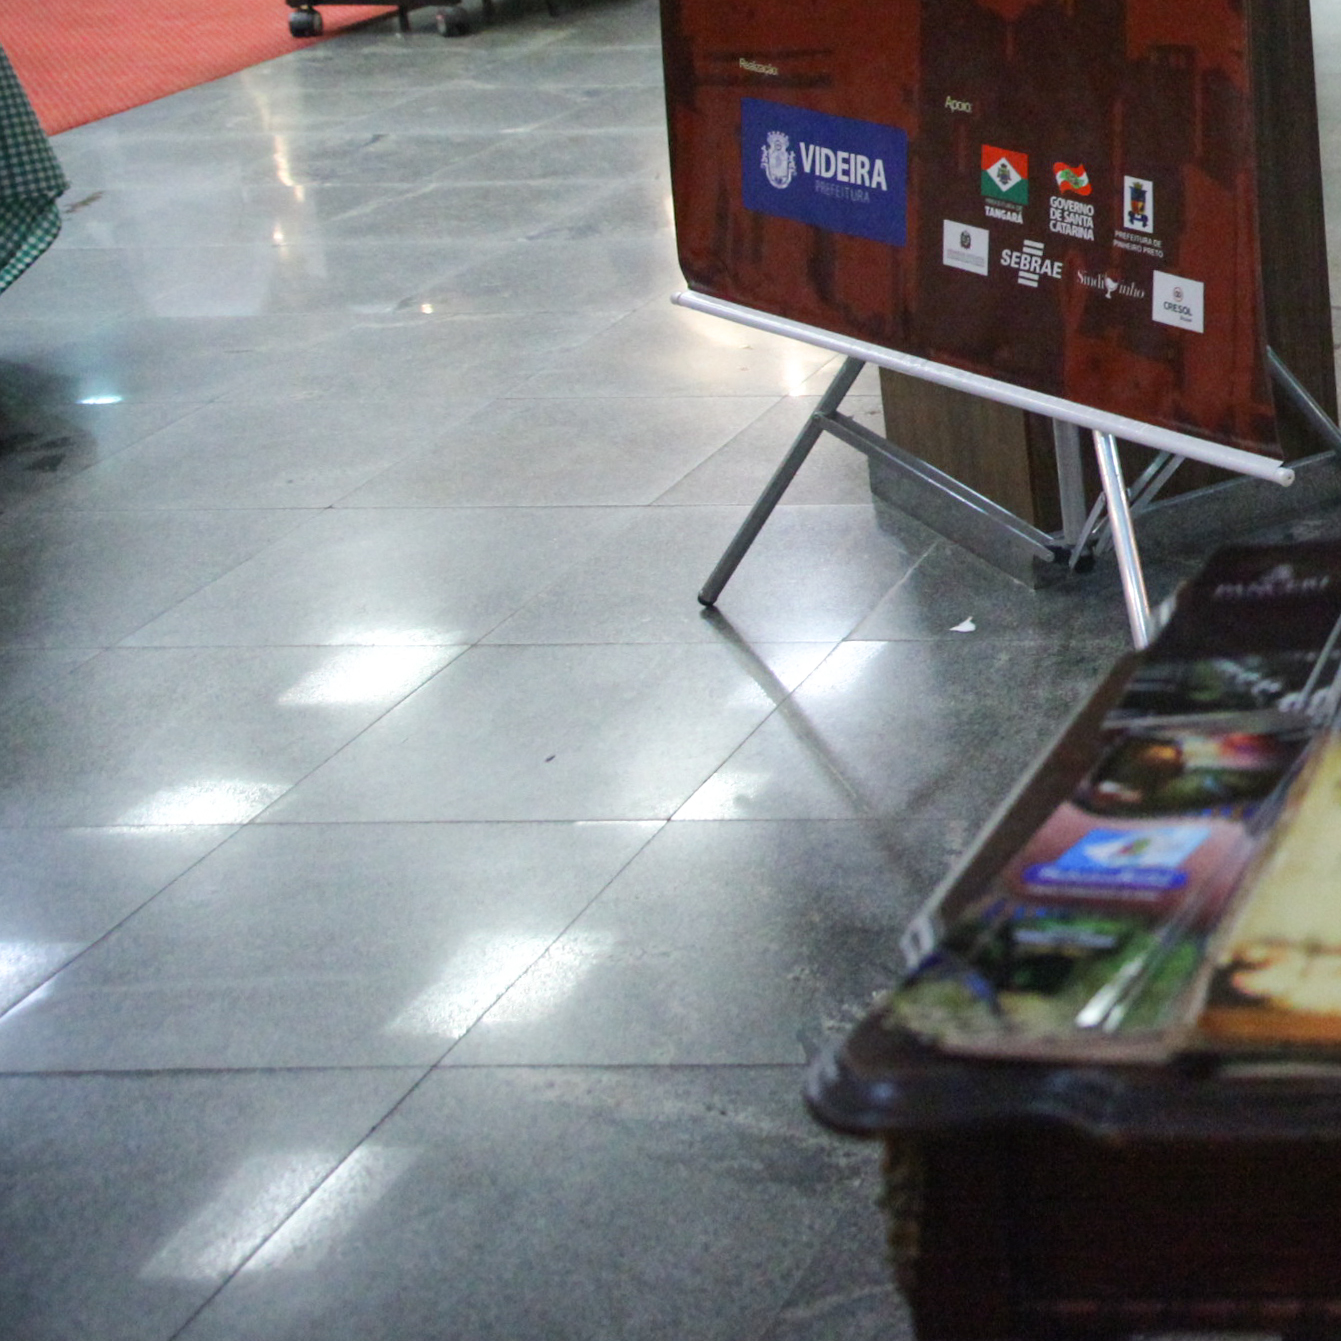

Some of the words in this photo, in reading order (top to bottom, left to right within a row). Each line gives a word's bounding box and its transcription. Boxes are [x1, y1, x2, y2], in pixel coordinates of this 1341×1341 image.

[799, 141, 888, 191] VIDEIRA
[815, 180, 870, 203] PREFEITURA
[984, 205, 1024, 224] TANGARÁ
[1050, 196, 1094, 216] GOVERNO
[1050, 208, 1063, 221] DE
[1064, 211, 1094, 228] SANTA
[1049, 222, 1095, 241] CATARINA
[1114, 230, 1153, 246] PREFEITURA
[1153, 239, 1163, 248] DE
[1113, 239, 1142, 253] PINHEIRO
[1143, 245, 1164, 258] PRETO
[1001, 249, 1063, 279] SEBRAE
[1163, 301, 1193, 316] CRESOL
